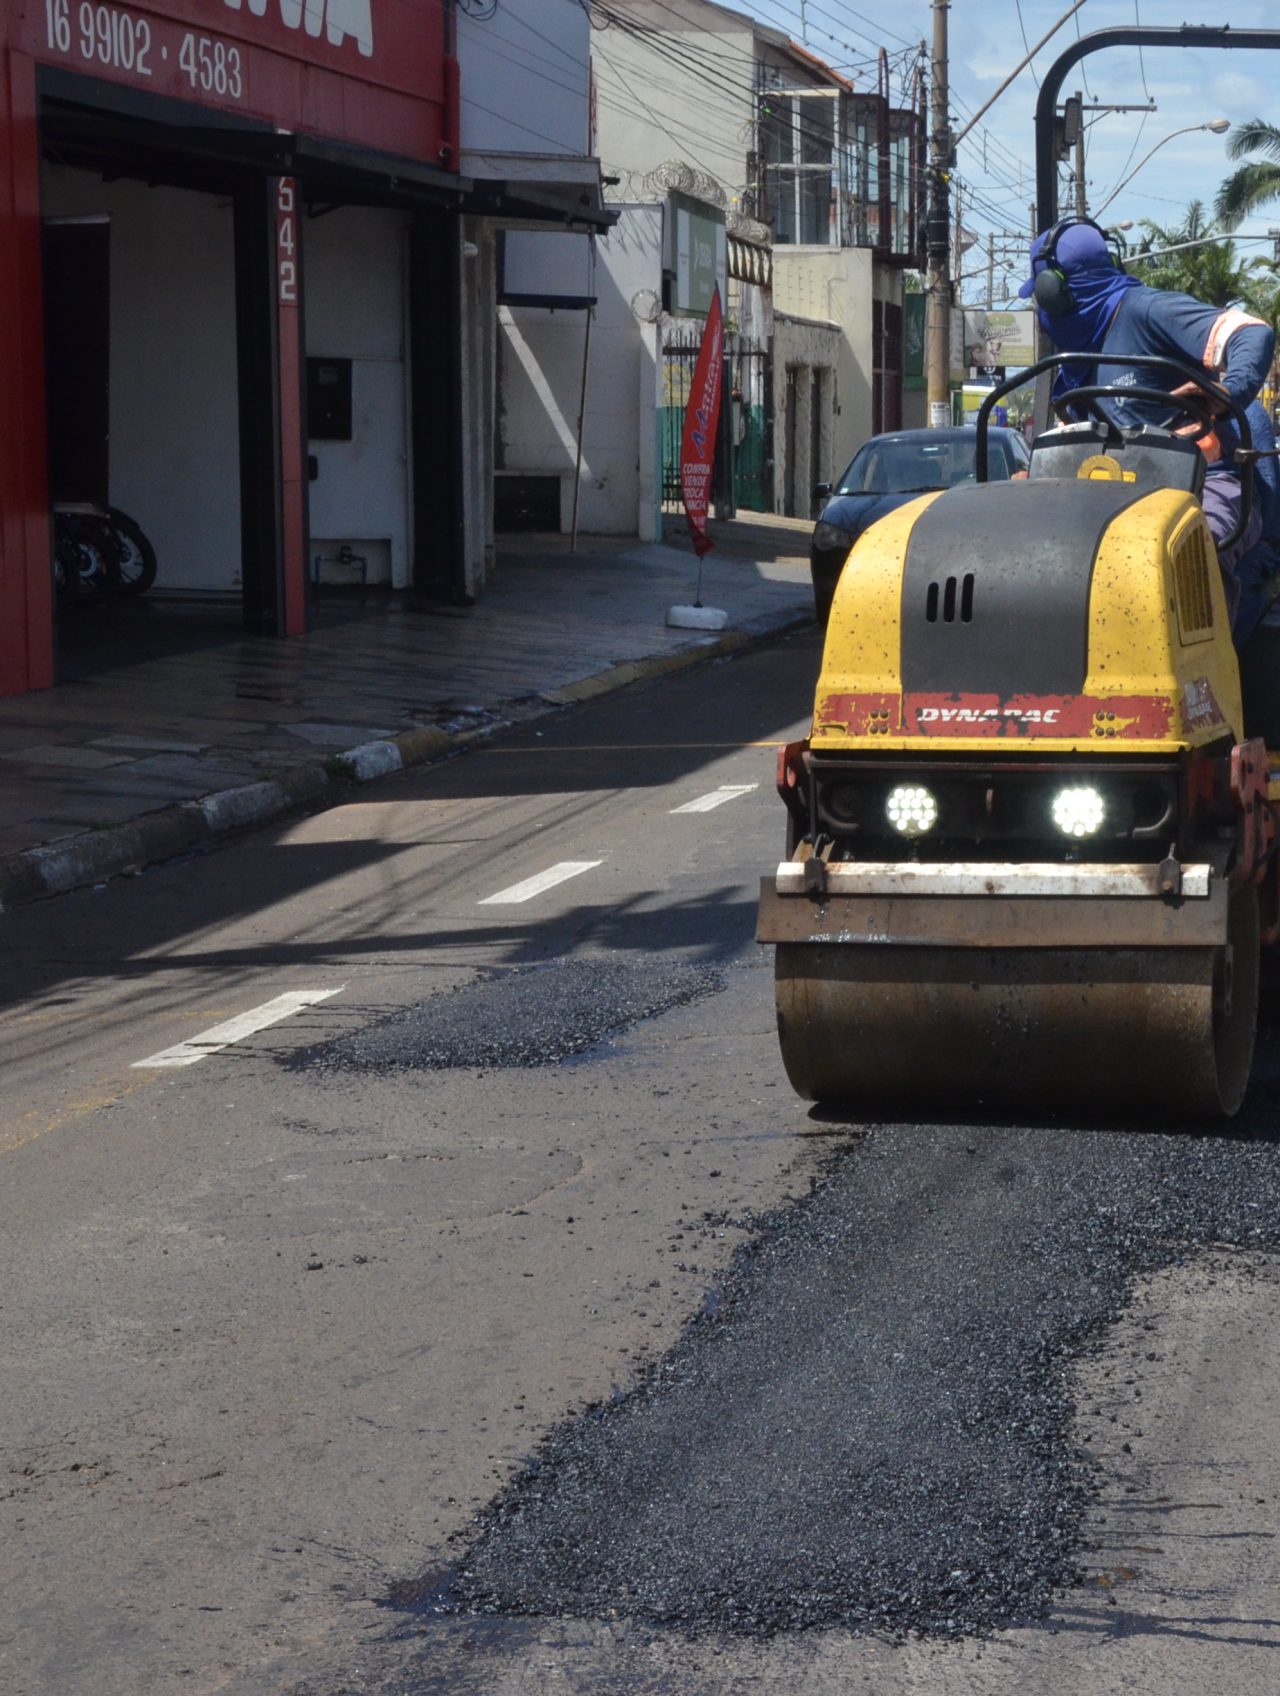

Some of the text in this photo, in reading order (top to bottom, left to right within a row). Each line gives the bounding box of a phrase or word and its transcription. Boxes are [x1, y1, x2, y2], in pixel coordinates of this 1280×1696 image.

[45, 0, 71, 52] 16
[79, 2, 152, 75] 99102
[179, 33, 242, 98] 4583
[917, 708, 1061, 722] DYNAPAC
